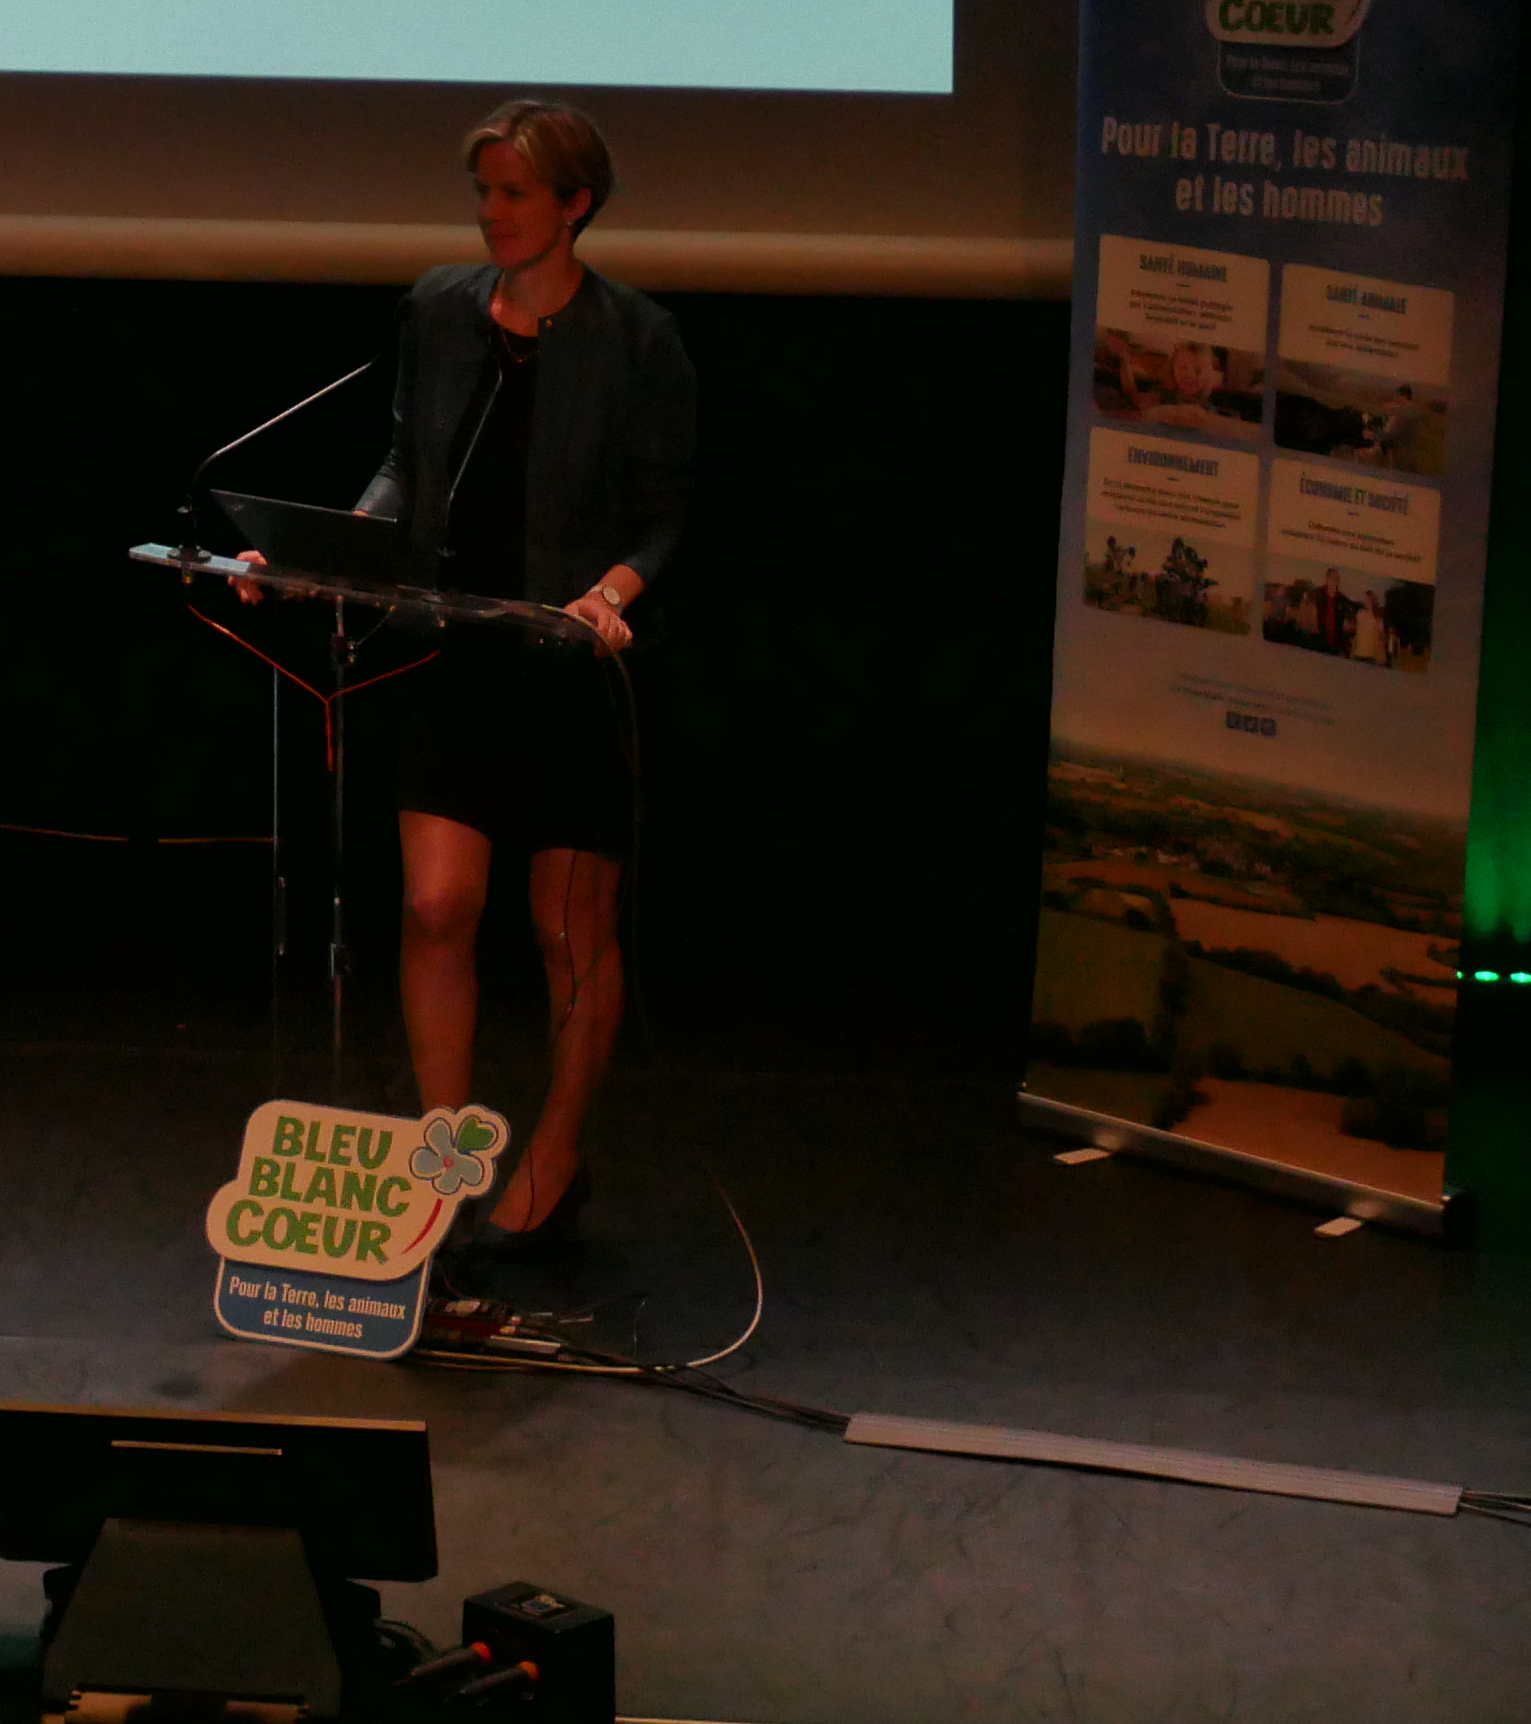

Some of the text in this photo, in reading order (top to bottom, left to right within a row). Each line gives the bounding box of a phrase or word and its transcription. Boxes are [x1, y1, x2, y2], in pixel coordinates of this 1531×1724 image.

[1102, 116, 1469, 180] Pour la Terre, les animaux
[1175, 174, 1384, 226] et les hommes
[272, 1115, 393, 1170] BLEU
[248, 1156, 412, 1218] BLANC
[228, 1276, 407, 1321] Pour la Terre, les animaux
[263, 1309, 364, 1339] et les hommes
